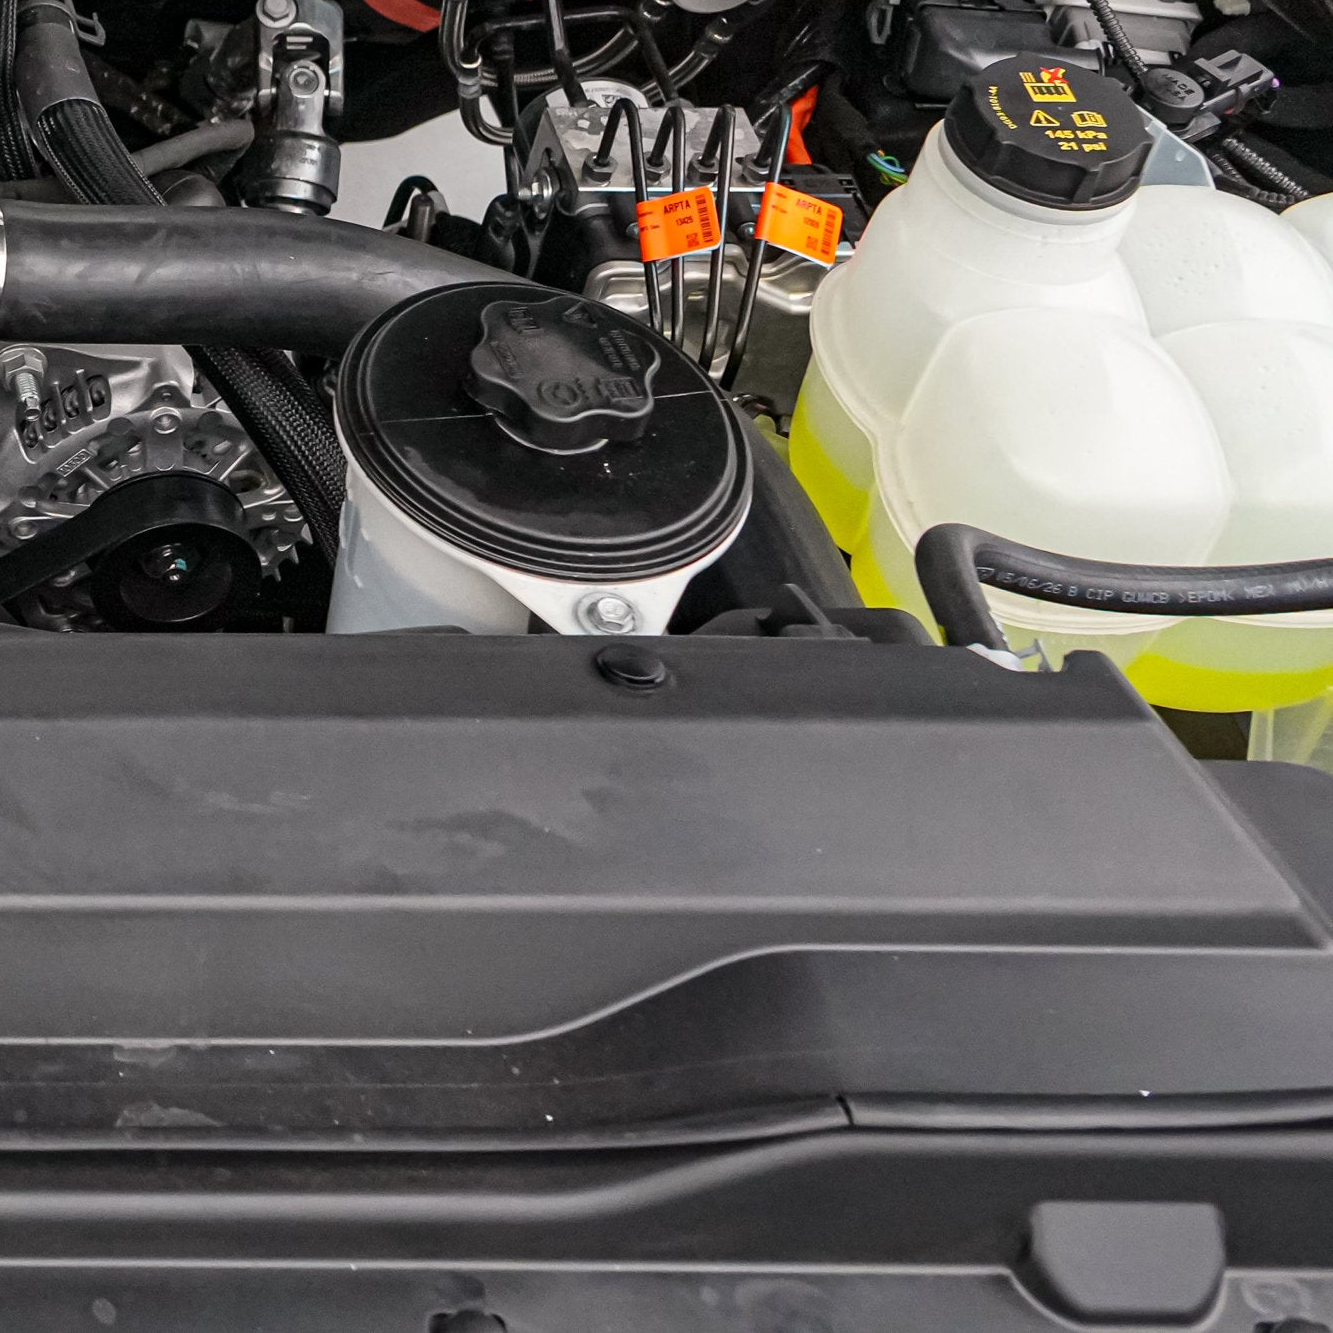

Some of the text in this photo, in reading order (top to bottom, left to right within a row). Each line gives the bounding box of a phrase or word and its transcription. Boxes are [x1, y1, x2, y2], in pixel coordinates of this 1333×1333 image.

[1044, 130, 1108, 139] 145 kPa
[1058, 141, 1108, 152] 21 psi
[663, 198, 691, 215] ARPTA
